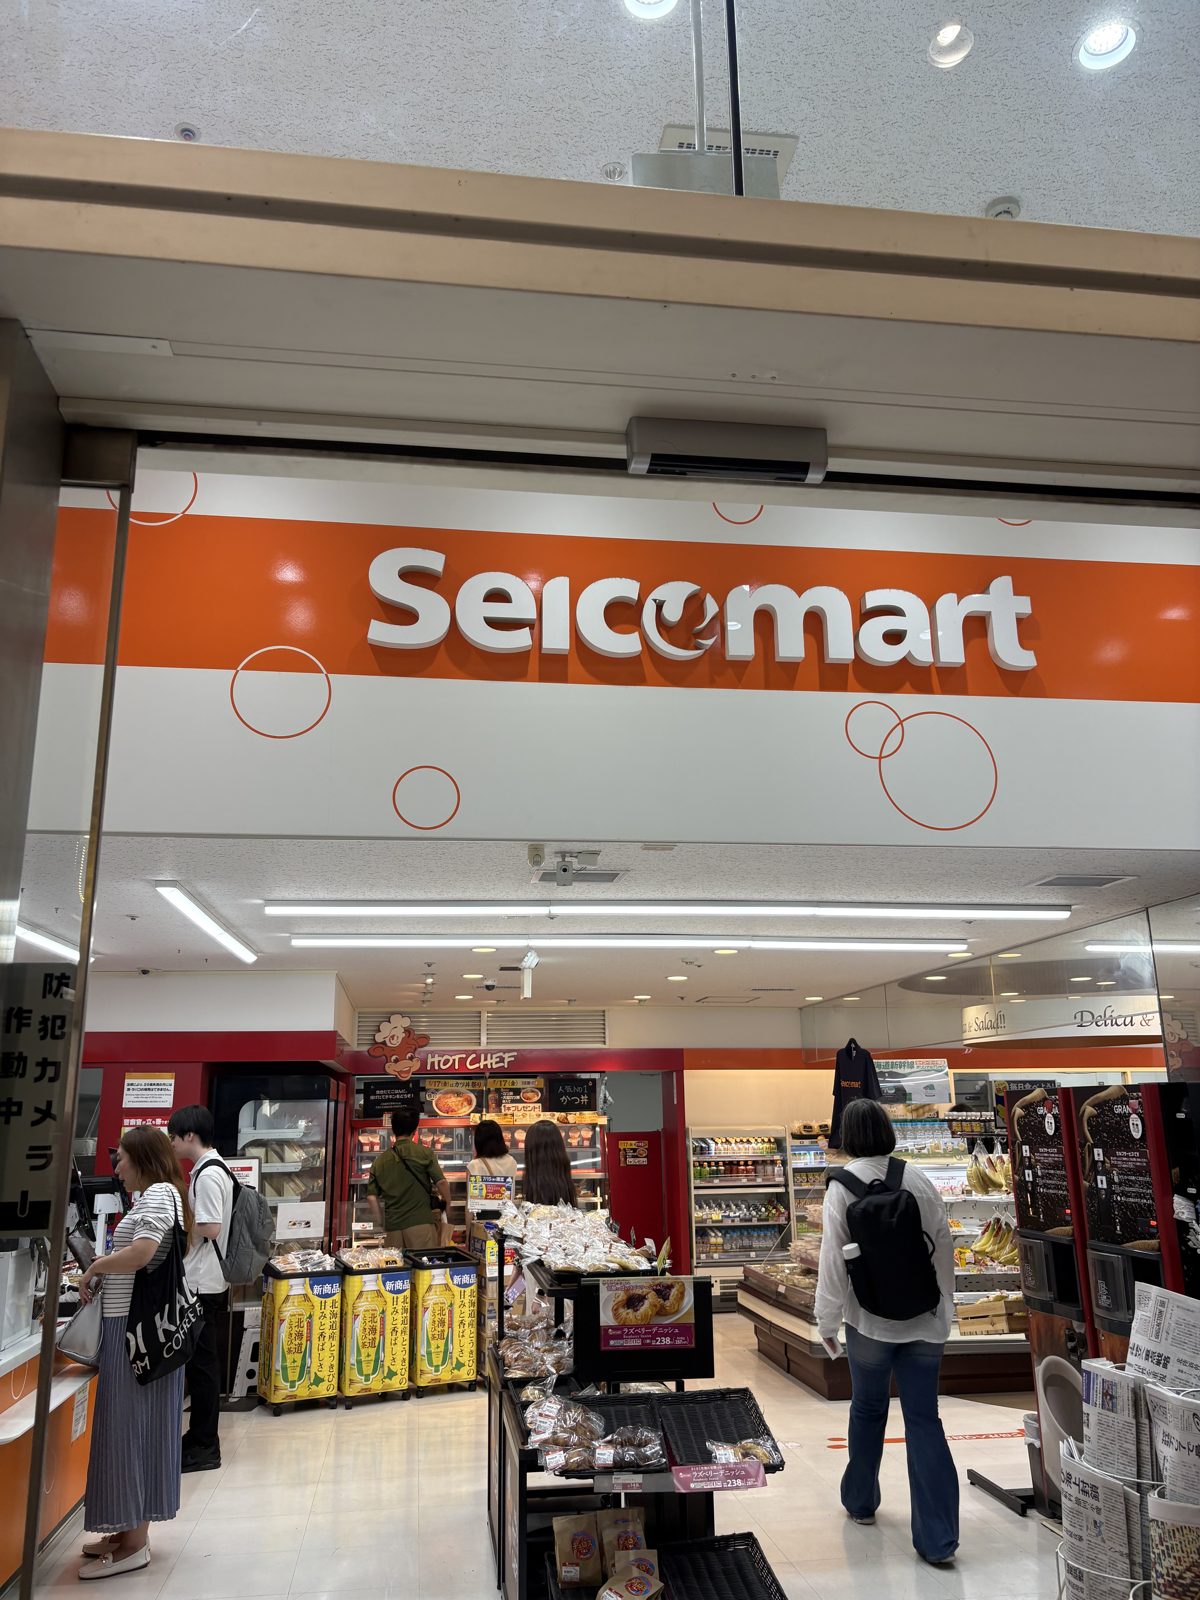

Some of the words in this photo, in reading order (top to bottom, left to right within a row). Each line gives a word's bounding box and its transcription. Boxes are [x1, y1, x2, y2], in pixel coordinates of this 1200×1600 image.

[366, 547, 1038, 672] Seicomart
[974, 1010, 1006, 1031] Salad!!
[1073, 1005, 1135, 1028] Delica
[1140, 1013, 1155, 1027] &
[427, 1053, 467, 1070] HOT
[466, 1051, 518, 1070] CHEF
[560, 1094, 589, 1104] かつ丼
[453, 1274, 477, 1285] 新商品
[313, 1284, 341, 1295] 新商品
[385, 1280, 410, 1291] 新商品
[437, 1306, 446, 1341] 北海道
[294, 1317, 304, 1354] 北海道
[367, 1313, 378, 1349] 北海道
[622, 1326, 680, 1335] ラズベリーデニッシュ
[655, 1336, 671, 1345] 238
[692, 1469, 746, 1479] ラズベリーデニッシュ
[727, 1479, 742, 1487] 238
